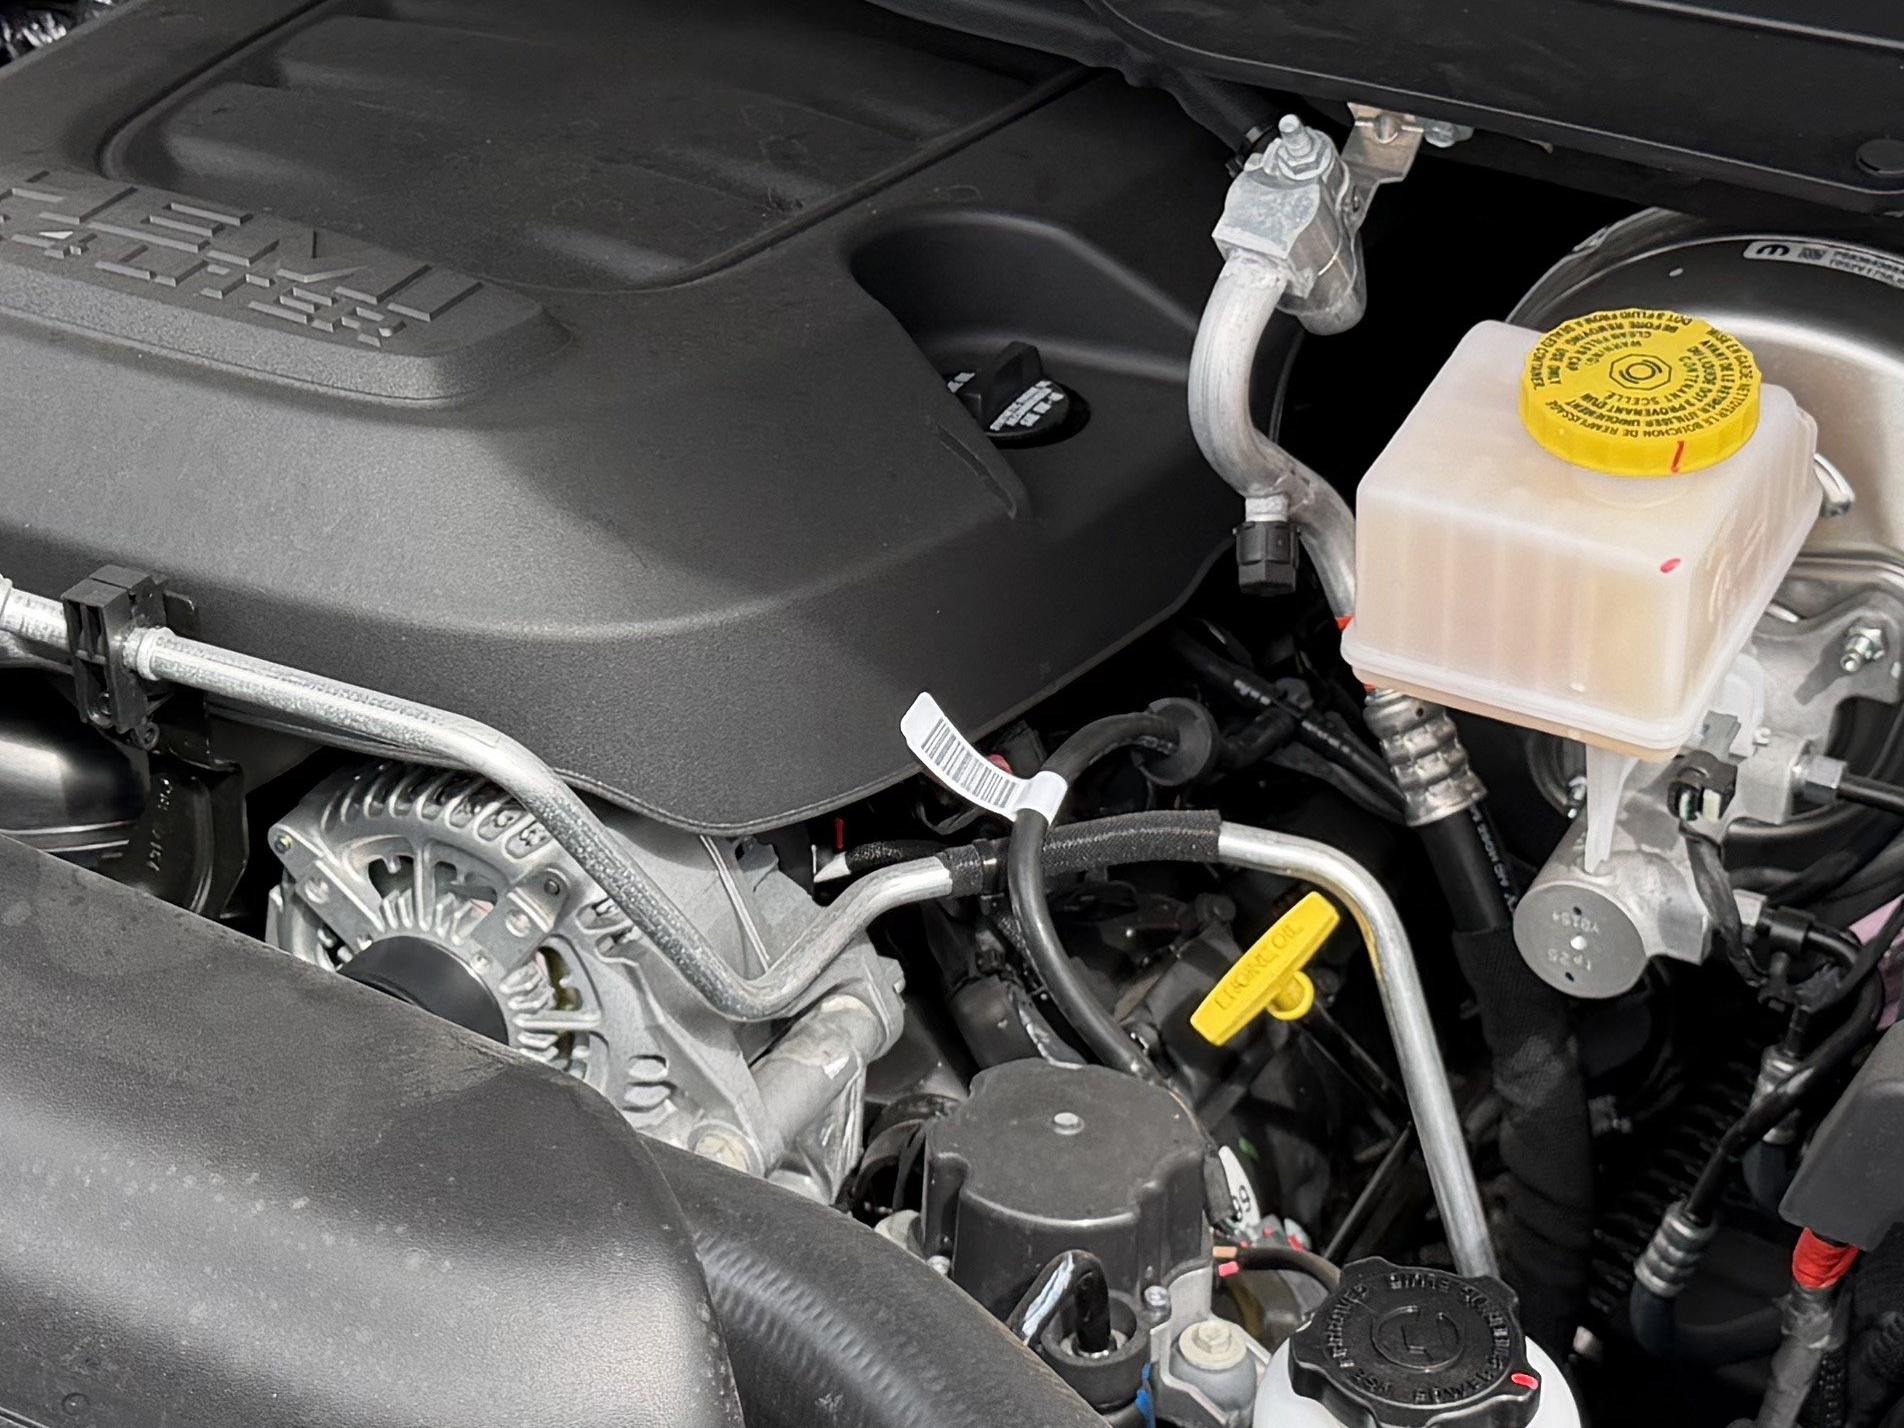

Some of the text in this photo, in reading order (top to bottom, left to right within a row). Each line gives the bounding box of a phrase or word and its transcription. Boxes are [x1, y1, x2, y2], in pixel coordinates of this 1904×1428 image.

[1604, 401, 1693, 419] PROVENANT
[1620, 428, 1638, 437] DE
[1642, 421, 1707, 438] BOUCHON
[1271, 922, 1304, 950] OIL
